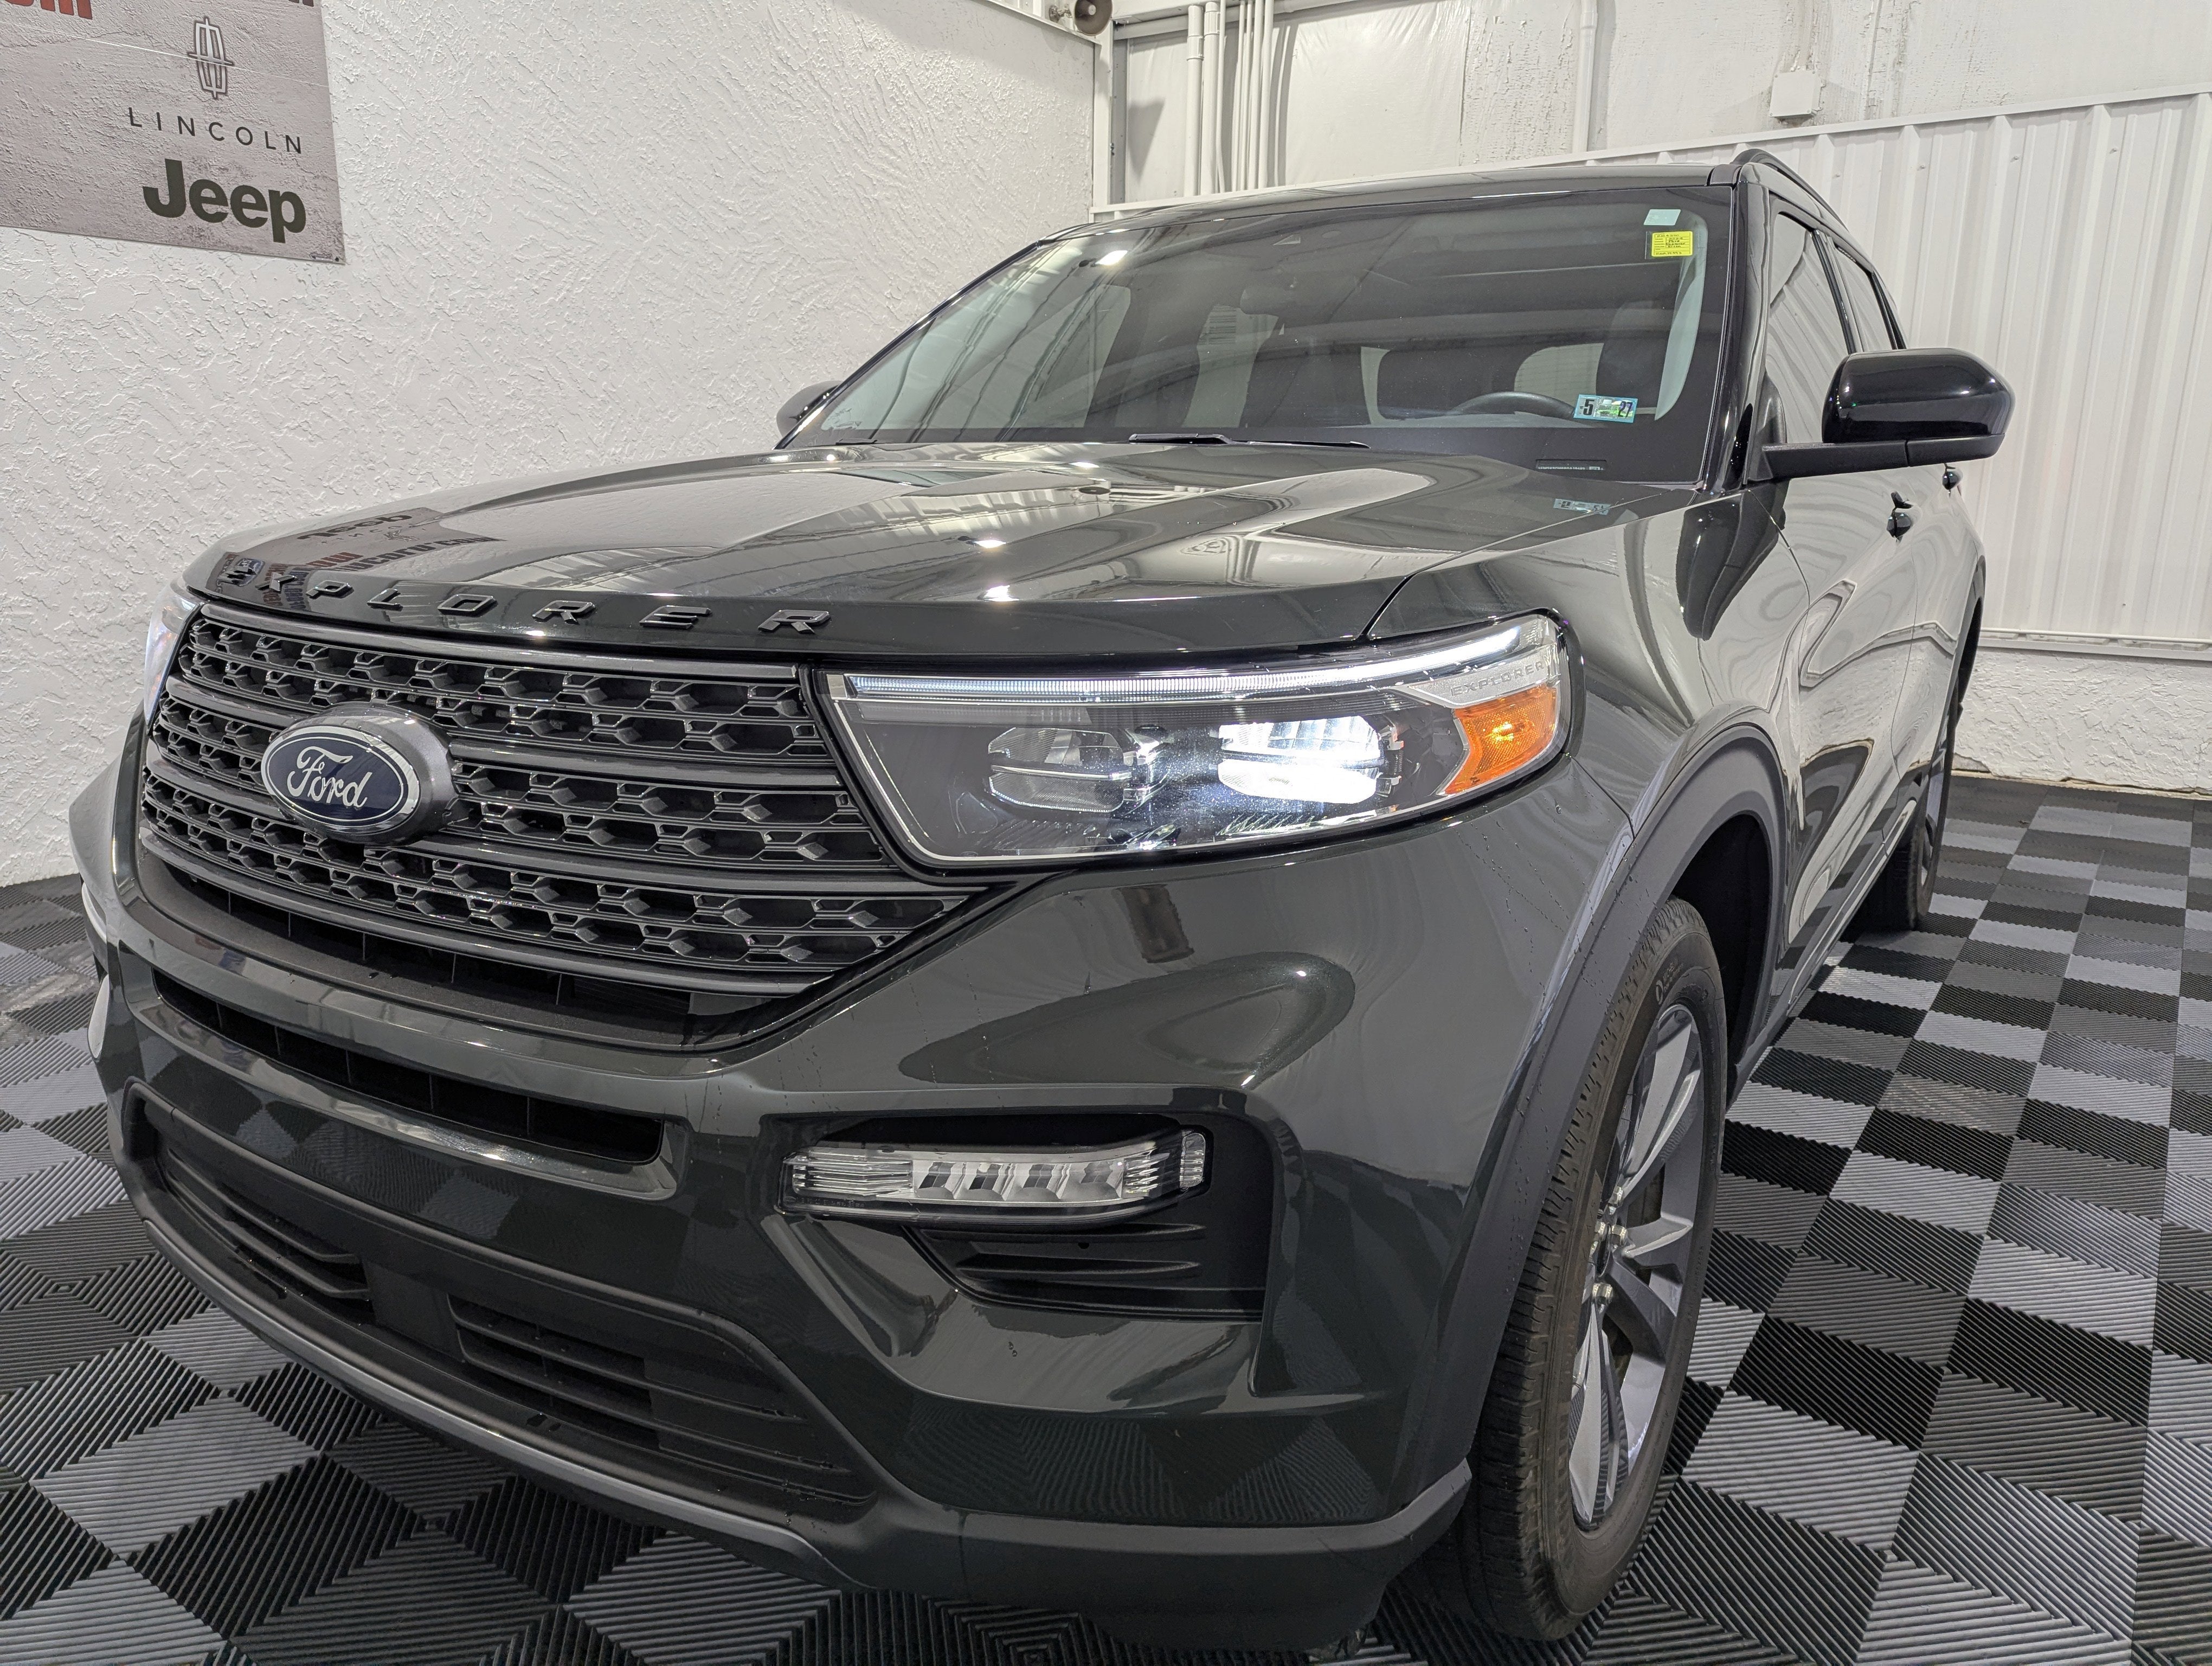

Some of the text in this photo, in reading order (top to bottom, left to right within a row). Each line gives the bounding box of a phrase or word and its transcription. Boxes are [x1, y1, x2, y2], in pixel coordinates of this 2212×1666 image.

[128, 107, 301, 154] LINCOLN
[143, 158, 306, 244] Jeep
[1583, 399, 1633, 418] 5 27
[218, 564, 832, 634] EXPLORER
[1450, 660, 1545, 697] EXPLORER
[287, 746, 373, 808] Ford
